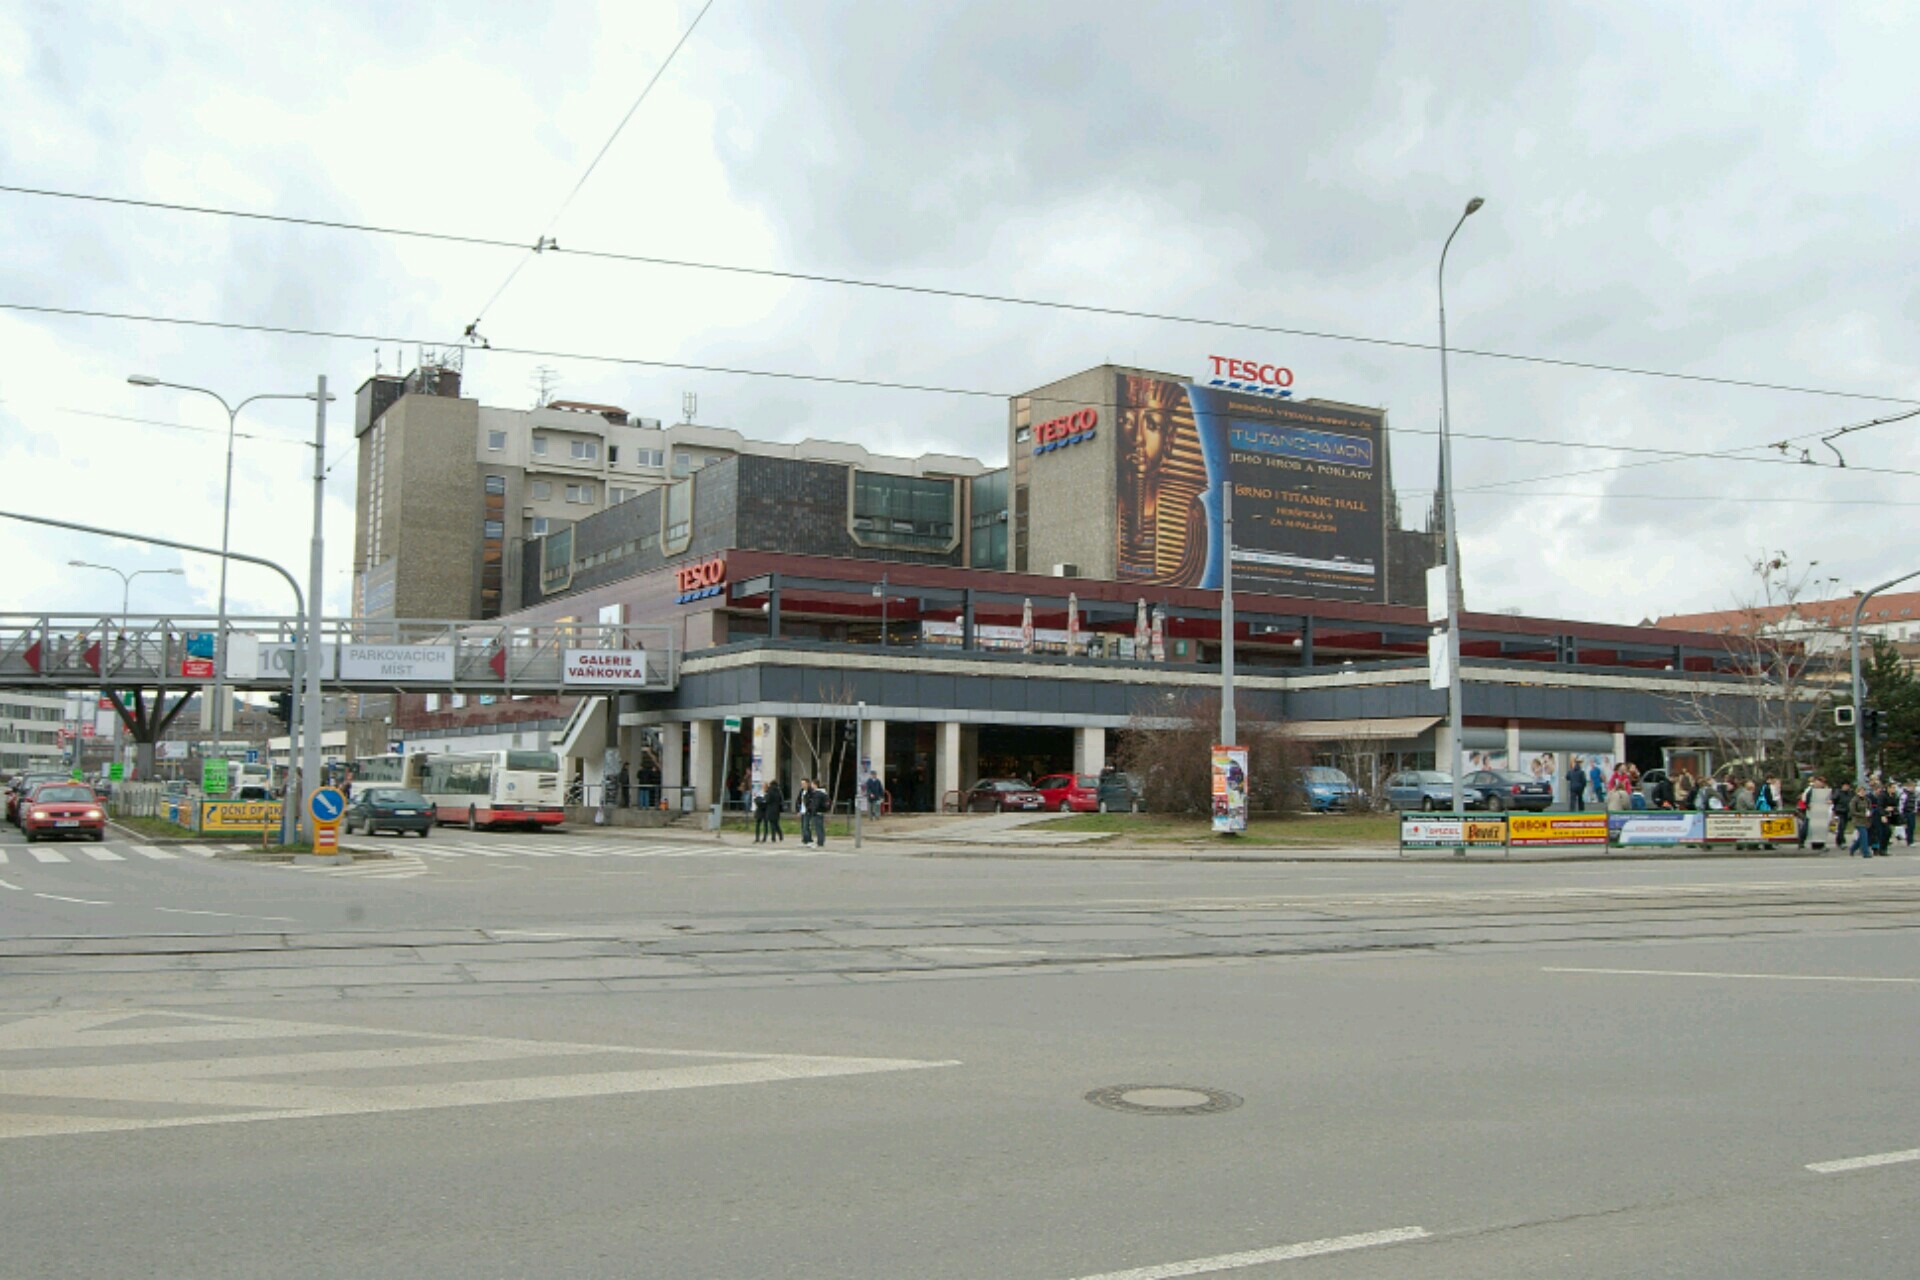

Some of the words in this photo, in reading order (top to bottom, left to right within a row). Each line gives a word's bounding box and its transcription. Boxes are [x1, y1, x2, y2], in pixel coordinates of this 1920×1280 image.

[1209, 355, 1293, 387] TESCO
[1033, 407, 1098, 445] TESCO
[1232, 429, 1369, 460] TUTANCHAMON
[1229, 453, 1262, 465] JEHO
[1266, 457, 1302, 471] HROB
[1305, 463, 1314, 472] A
[1318, 465, 1373, 480] POKLADY
[1235, 484, 1272, 499] BRNO
[1280, 491, 1332, 507] TITANIC
[1335, 499, 1368, 512] HALL
[674, 558, 726, 592] TESCO
[349, 646, 446, 662] PARKOVACÍCH
[578, 655, 632, 666] GALERIE
[380, 662, 413, 675] MÍST
[568, 664, 642, 679] VAŇKOVKA
[221, 804, 246, 815] OČNÍ
